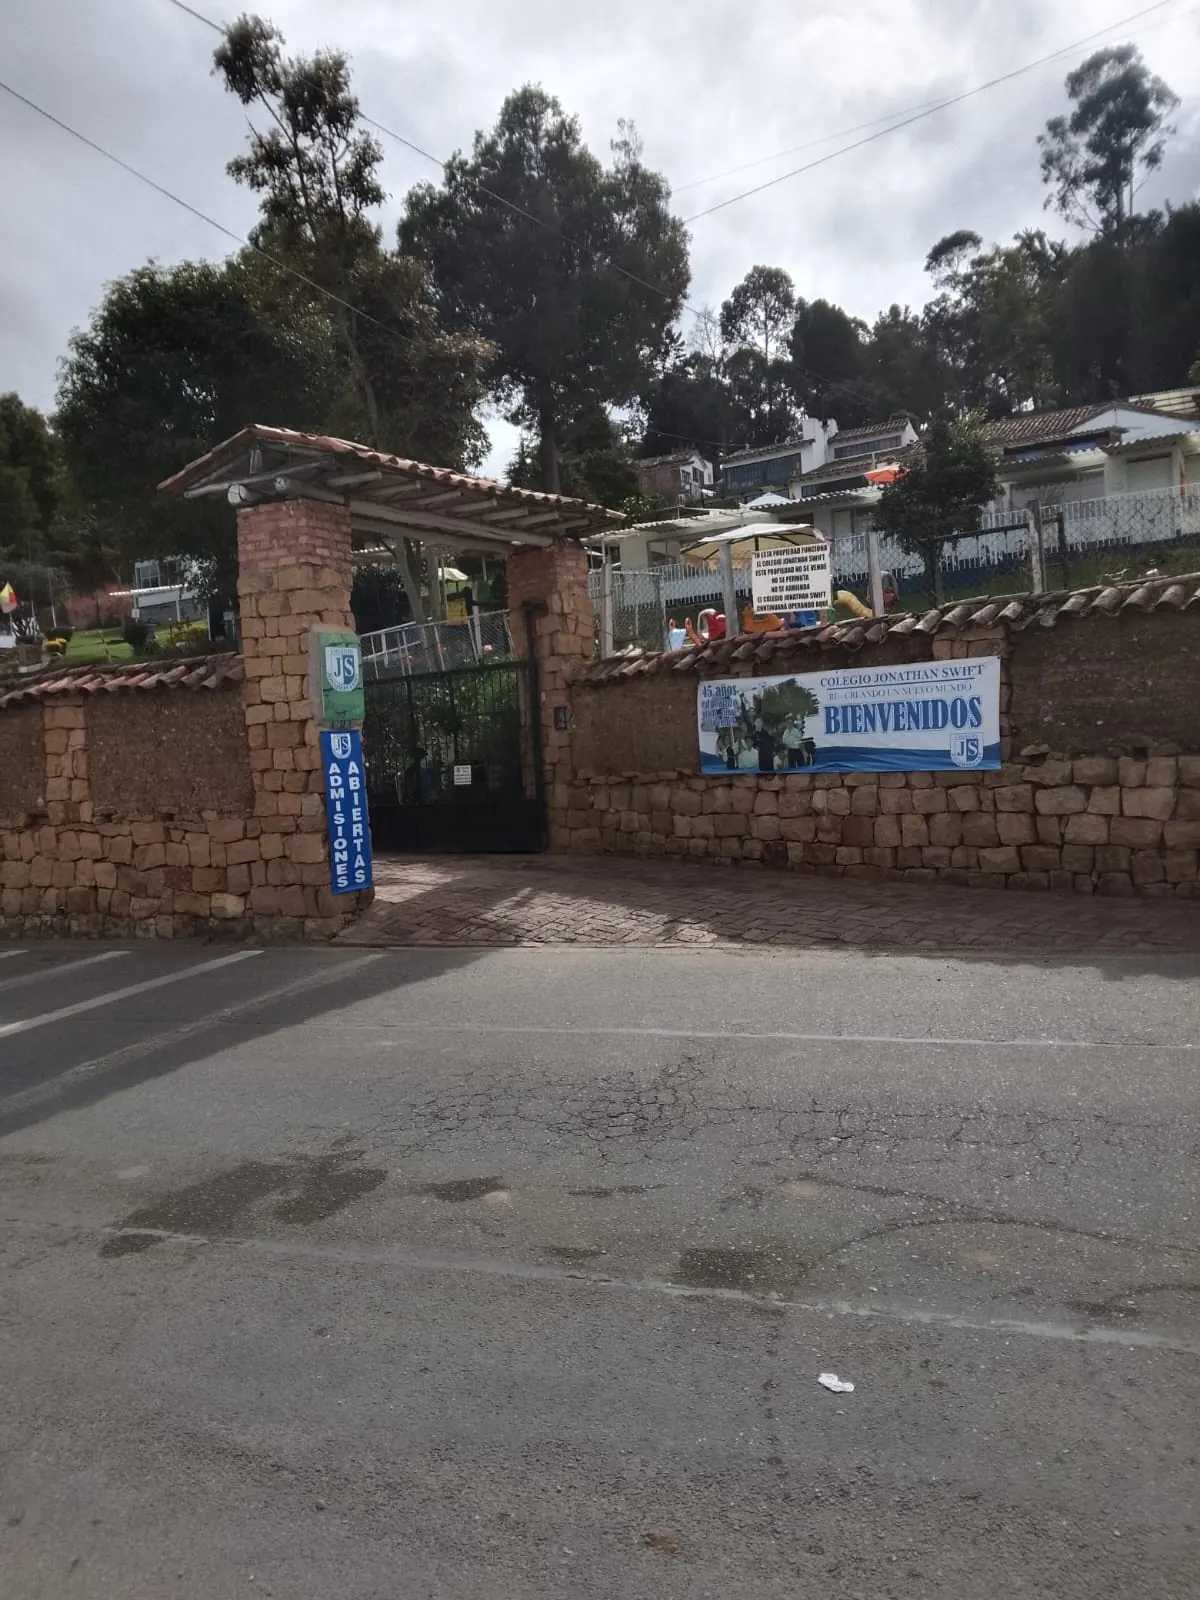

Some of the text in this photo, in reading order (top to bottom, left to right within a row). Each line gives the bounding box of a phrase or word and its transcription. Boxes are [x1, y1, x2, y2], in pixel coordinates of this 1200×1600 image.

[773, 548, 800, 556] PROPIEDAD
[762, 558, 782, 566] COLEGIO
[783, 557, 807, 565] JONATHAN
[809, 554, 825, 562] SWIFT
[768, 567, 794, 575] PROPIEDAD
[784, 593, 809, 601] JONATHAN
[788, 601, 814, 609] OPERANDO
[820, 664, 985, 687] COLEGIO JONATHAN SWIFT
[715, 684, 736, 697] años
[902, 686, 934, 697] NUEVO
[936, 684, 972, 693] MUNDO
[824, 696, 982, 734] BIENVENIDOS
[329, 762, 349, 888] ADMISIONES
[347, 760, 365, 883] ABIERTAS
